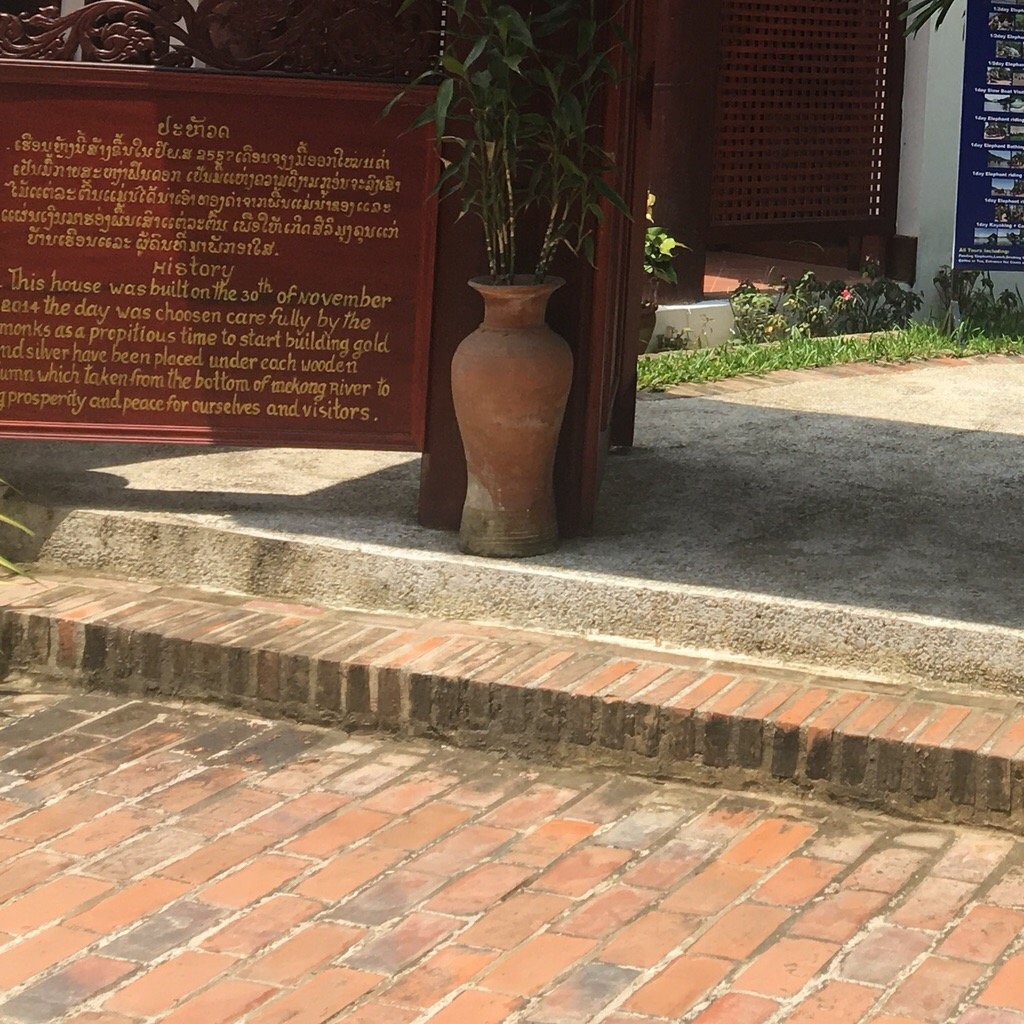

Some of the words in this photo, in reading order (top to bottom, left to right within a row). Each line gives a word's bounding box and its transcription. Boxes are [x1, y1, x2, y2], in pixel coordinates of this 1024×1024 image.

[9, 267, 45, 291] This
[51, 270, 101, 294] house
[109, 282, 147, 296] was
[150, 278, 189, 298] built
[191, 286, 210, 300] on
[213, 281, 237, 301] the
[241, 277, 273, 302] 30th
[277, 285, 298, 305] of
[0, 298, 40, 313] 2014
[44, 295, 71, 316] the
[74, 298, 110, 325] day
[116, 306, 152, 319] was
[155, 302, 221, 323] choosen
[318, 308, 340, 335] by
[342, 310, 371, 330] the
[0, 320, 50, 338] monks
[55, 326, 73, 338] as
[74, 327, 85, 339] a
[89, 322, 176, 346] propitious
[181, 327, 217, 346] time
[222, 328, 236, 344] to
[240, 328, 281, 348] start
[286, 331, 349, 357] building
[353, 331, 391, 359] gold
[28, 338, 70, 359] silver
[72, 342, 108, 363] have
[111, 344, 152, 364] been
[154, 345, 204, 368] placed
[209, 351, 257, 369] under
[261, 352, 297, 371] each
[301, 355, 358, 373] wooden
[38, 362, 80, 384] which
[84, 364, 131, 386] taken
[130, 367, 164, 388] from
[167, 369, 192, 389] the
[194, 370, 250, 392] bottom
[254, 374, 271, 392] of
[271, 377, 326, 401] mekong
[330, 379, 371, 396] River
[377, 376, 390, 397] to
[8, 389, 87, 415] prosperity
[89, 390, 121, 409] and
[122, 396, 164, 415] peace
[165, 395, 191, 412] for
[191, 393, 260, 415] ourselves
[266, 398, 300, 416] and
